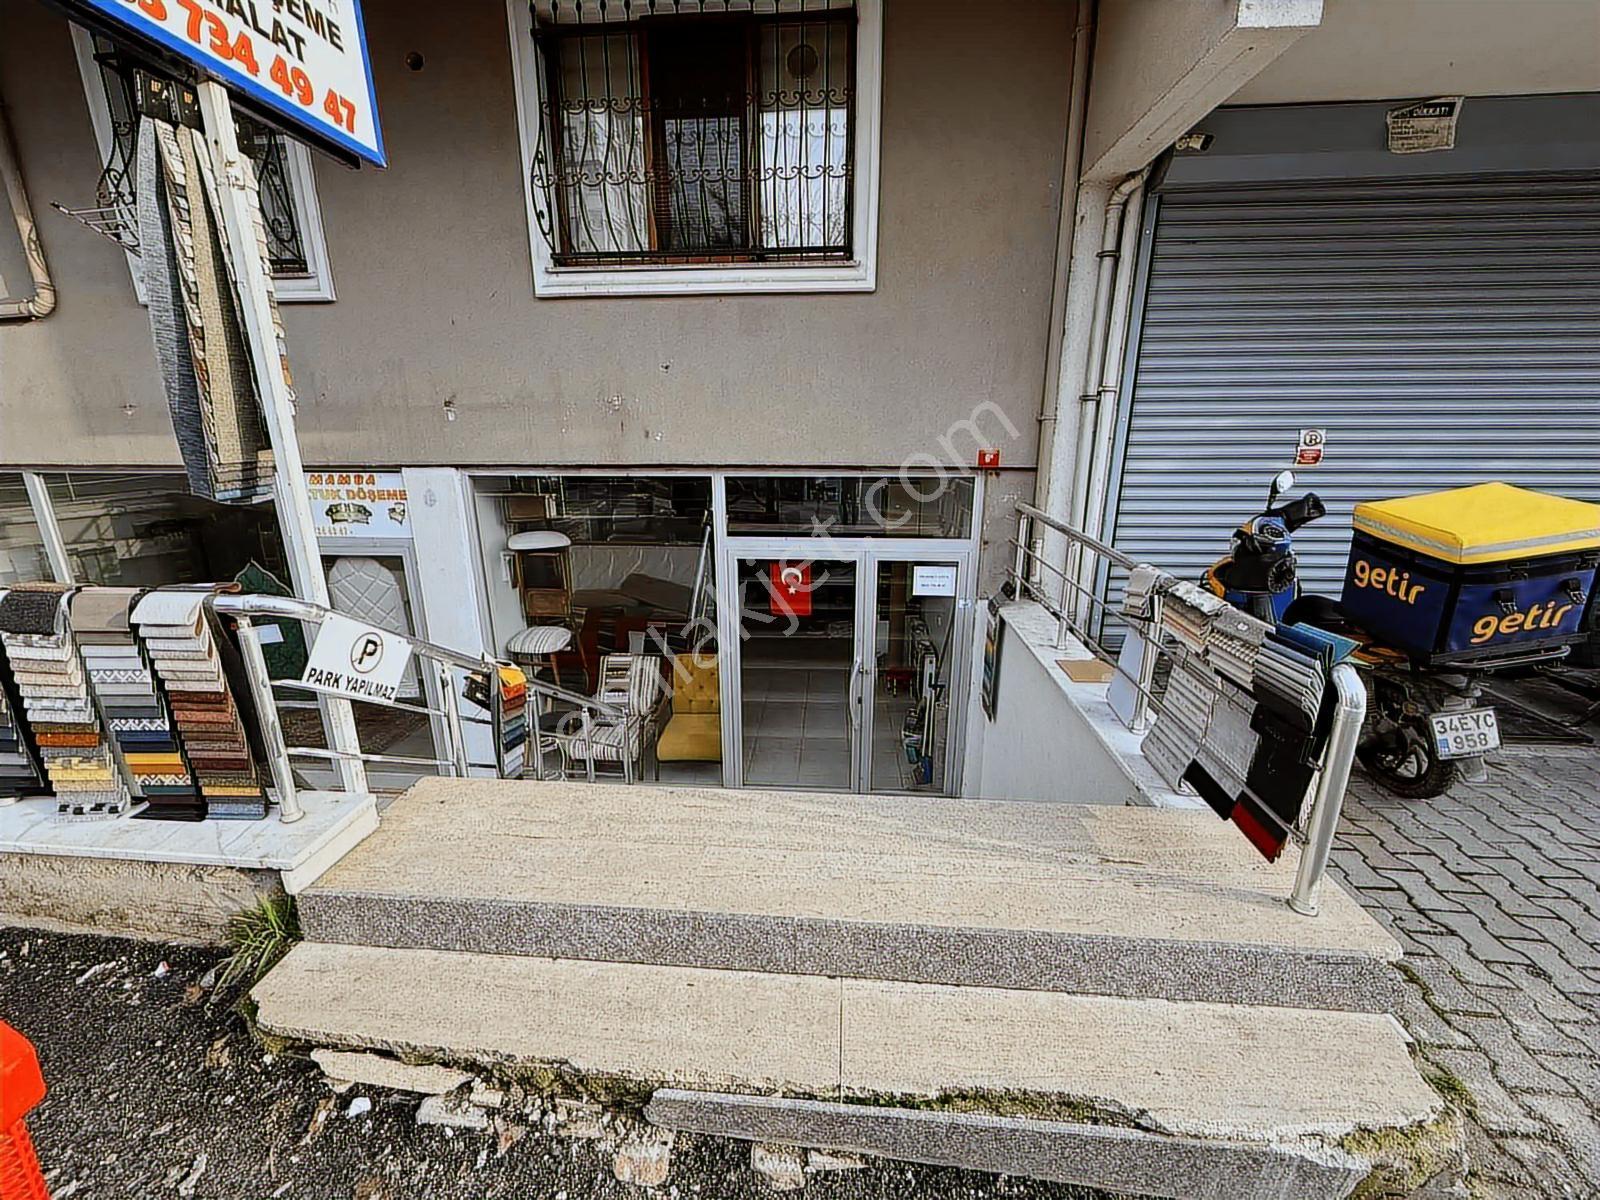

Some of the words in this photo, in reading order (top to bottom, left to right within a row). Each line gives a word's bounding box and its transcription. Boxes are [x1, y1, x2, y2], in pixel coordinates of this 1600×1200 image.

[176, 0, 260, 77] 734
[269, 54, 314, 106] 49
[323, 88, 356, 134] 47
[346, 487, 407, 502] DÖŞEME
[1354, 560, 1425, 605] getir
[1470, 600, 1573, 645] getir
[306, 667, 343, 689] PARK
[345, 675, 396, 700] YAPILMAZ
[1453, 732, 1489, 750] 958
